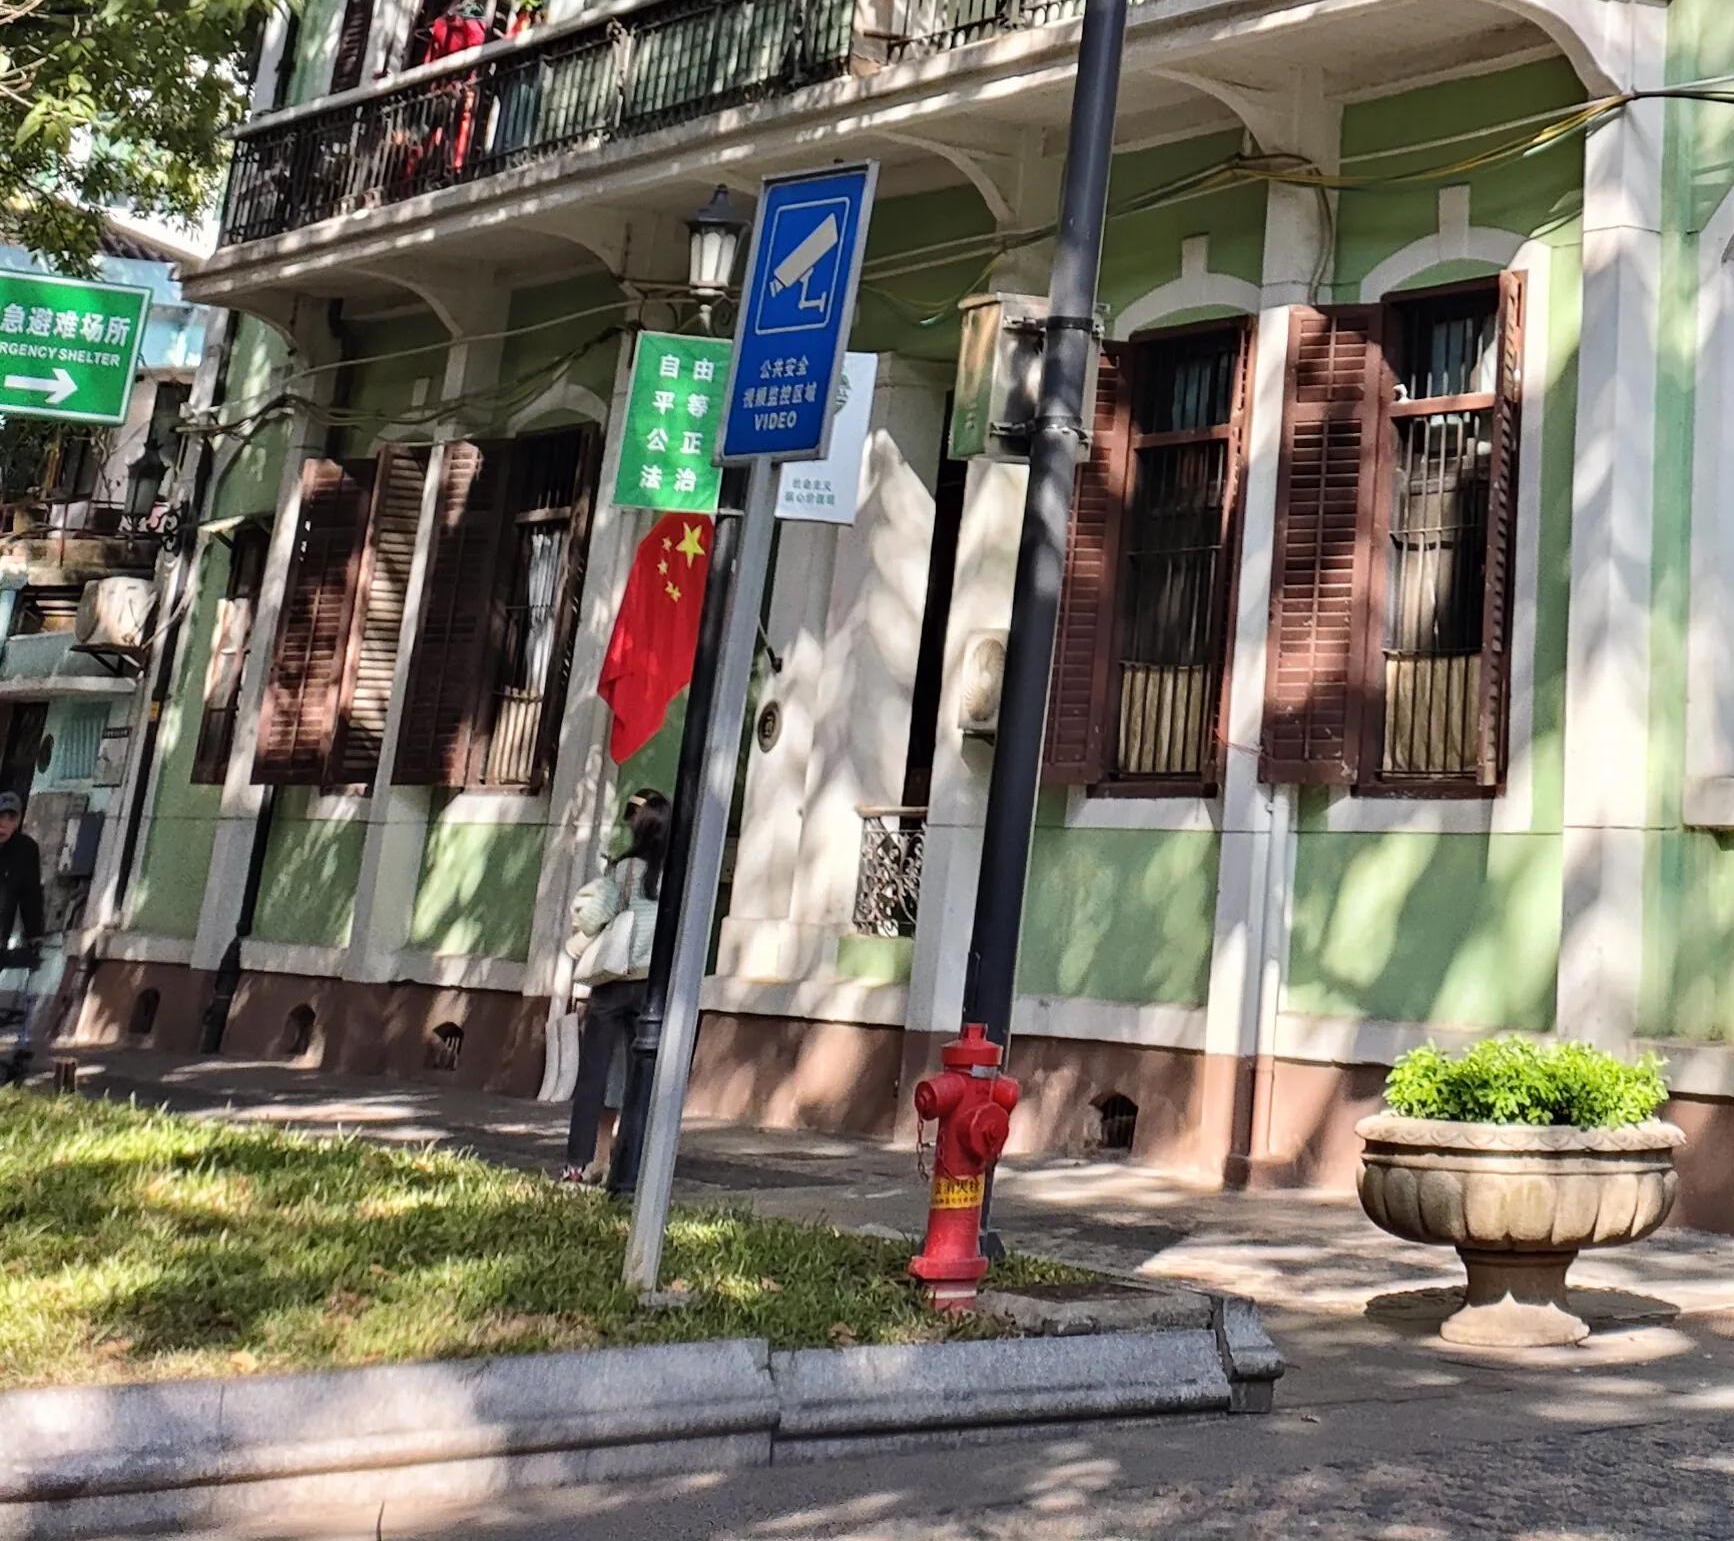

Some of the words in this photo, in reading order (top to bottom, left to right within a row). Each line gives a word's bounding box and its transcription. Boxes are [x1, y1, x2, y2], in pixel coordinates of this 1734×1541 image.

[1, 302, 131, 347] 急避难场所
[58, 348, 121, 367] SHELTER
[659, 354, 715, 383] 自由
[759, 354, 809, 379] 公共安全
[652, 390, 711, 418] 平等
[754, 410, 798, 432] VIDEO
[646, 428, 704, 455] 公正
[639, 464, 697, 493] 法治
